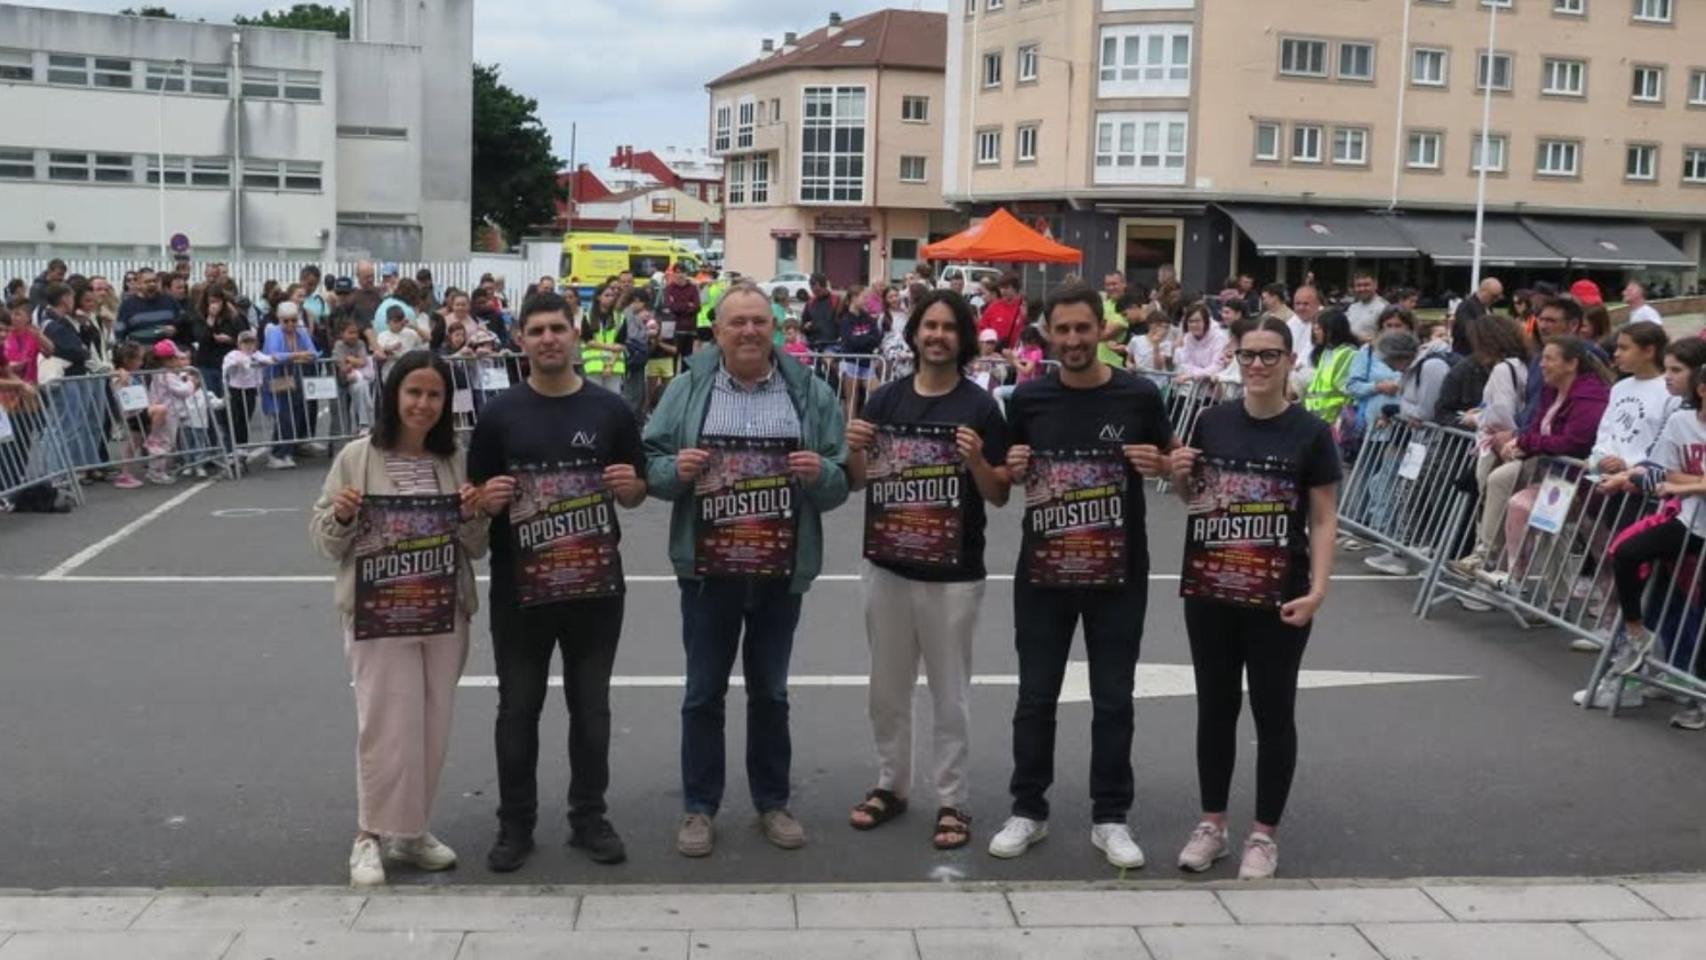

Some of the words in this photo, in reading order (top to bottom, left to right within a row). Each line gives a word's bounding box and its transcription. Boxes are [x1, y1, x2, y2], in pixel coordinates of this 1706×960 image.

[702, 487, 790, 521] APÓSTOLO
[873, 477, 958, 504] APÓSTOLO
[518, 504, 609, 547] APÓSTOLO
[1032, 496, 1121, 532] APÓSTOLO
[1194, 512, 1288, 541] APÓSTOLO
[362, 545, 454, 582] APÓSTOLO
